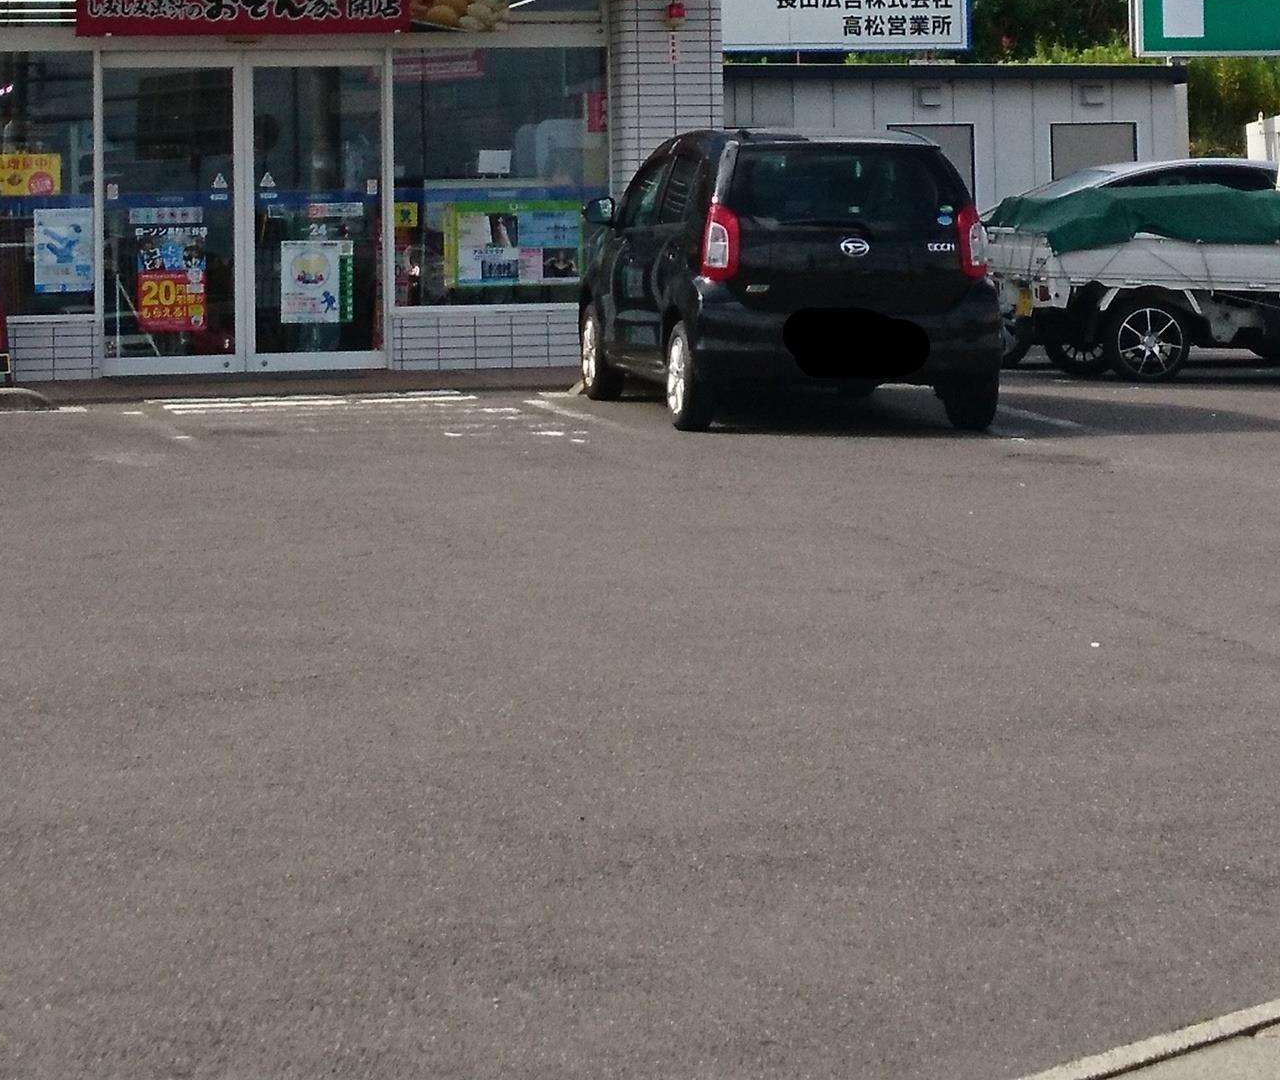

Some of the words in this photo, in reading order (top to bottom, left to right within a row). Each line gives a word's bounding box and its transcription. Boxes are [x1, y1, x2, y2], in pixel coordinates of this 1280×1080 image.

[842, 14, 952, 37] 高松営業所
